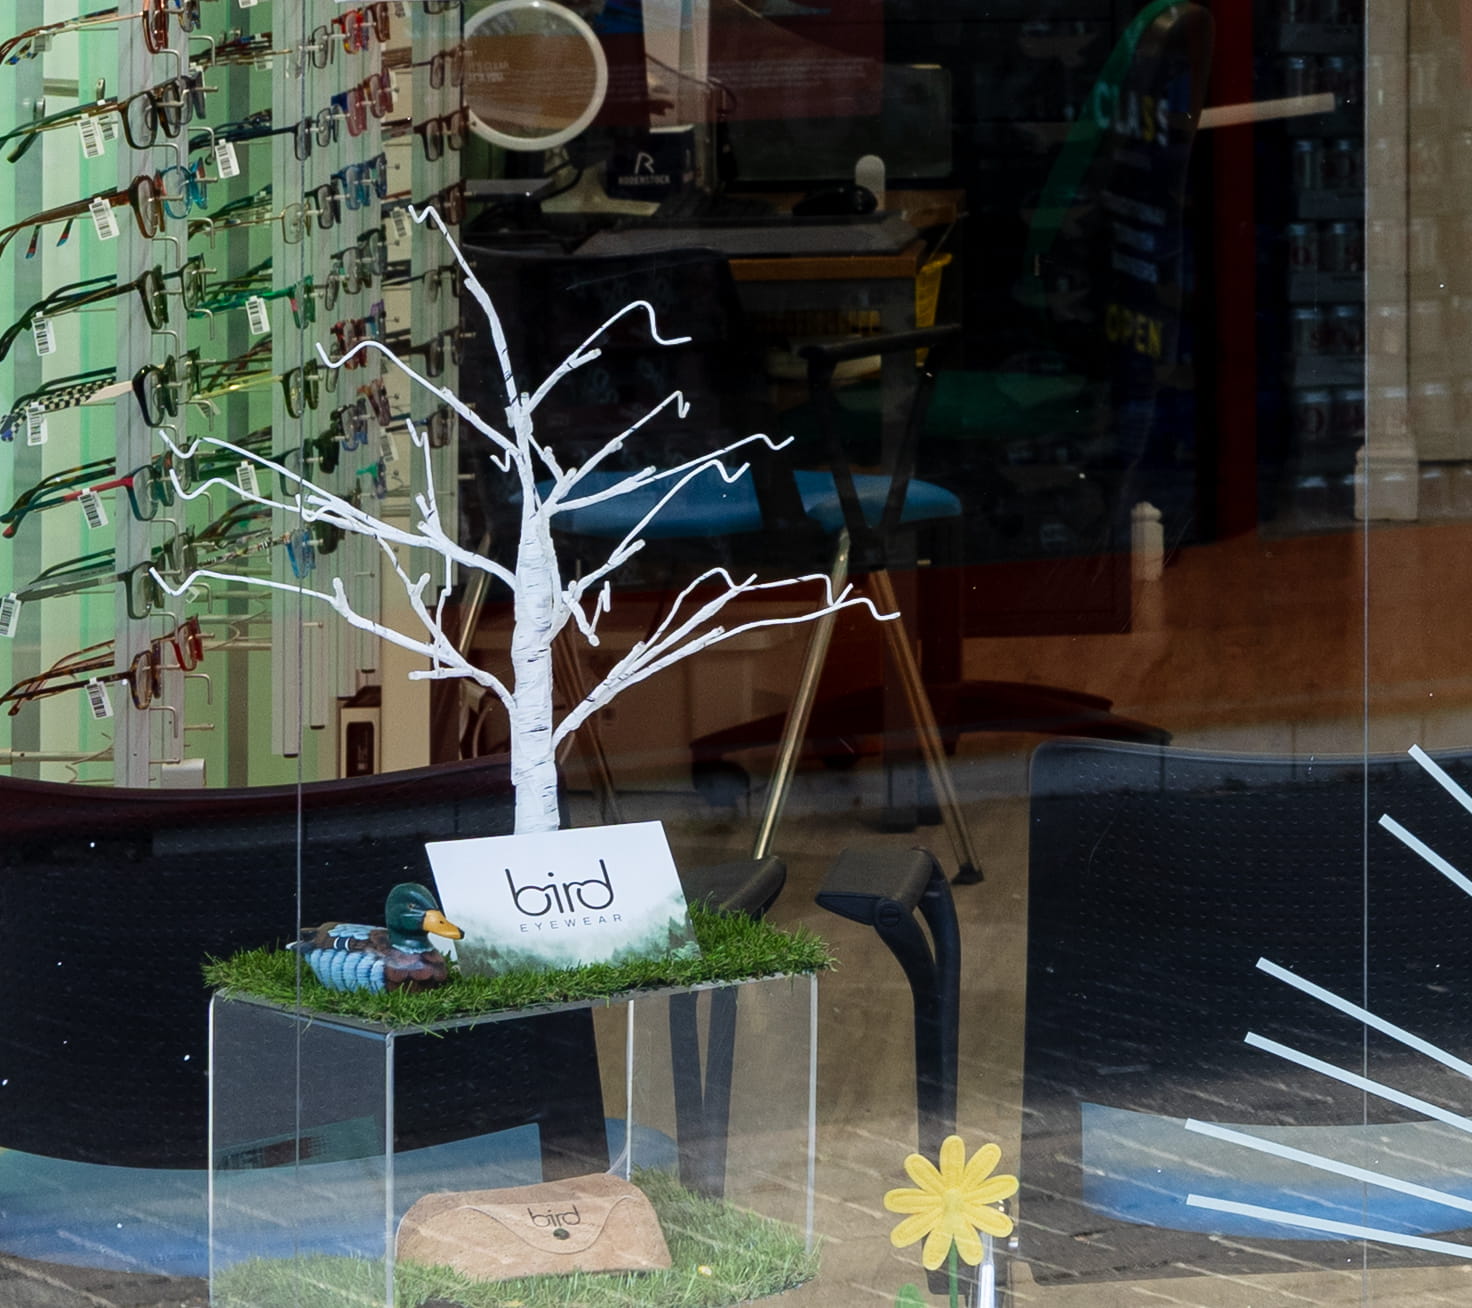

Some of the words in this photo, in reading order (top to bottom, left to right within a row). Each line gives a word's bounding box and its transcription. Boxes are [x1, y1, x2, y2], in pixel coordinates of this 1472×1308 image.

[503, 858, 617, 917] bird
[519, 913, 625, 935] EYEWEAR
[528, 1204, 582, 1228] bird
